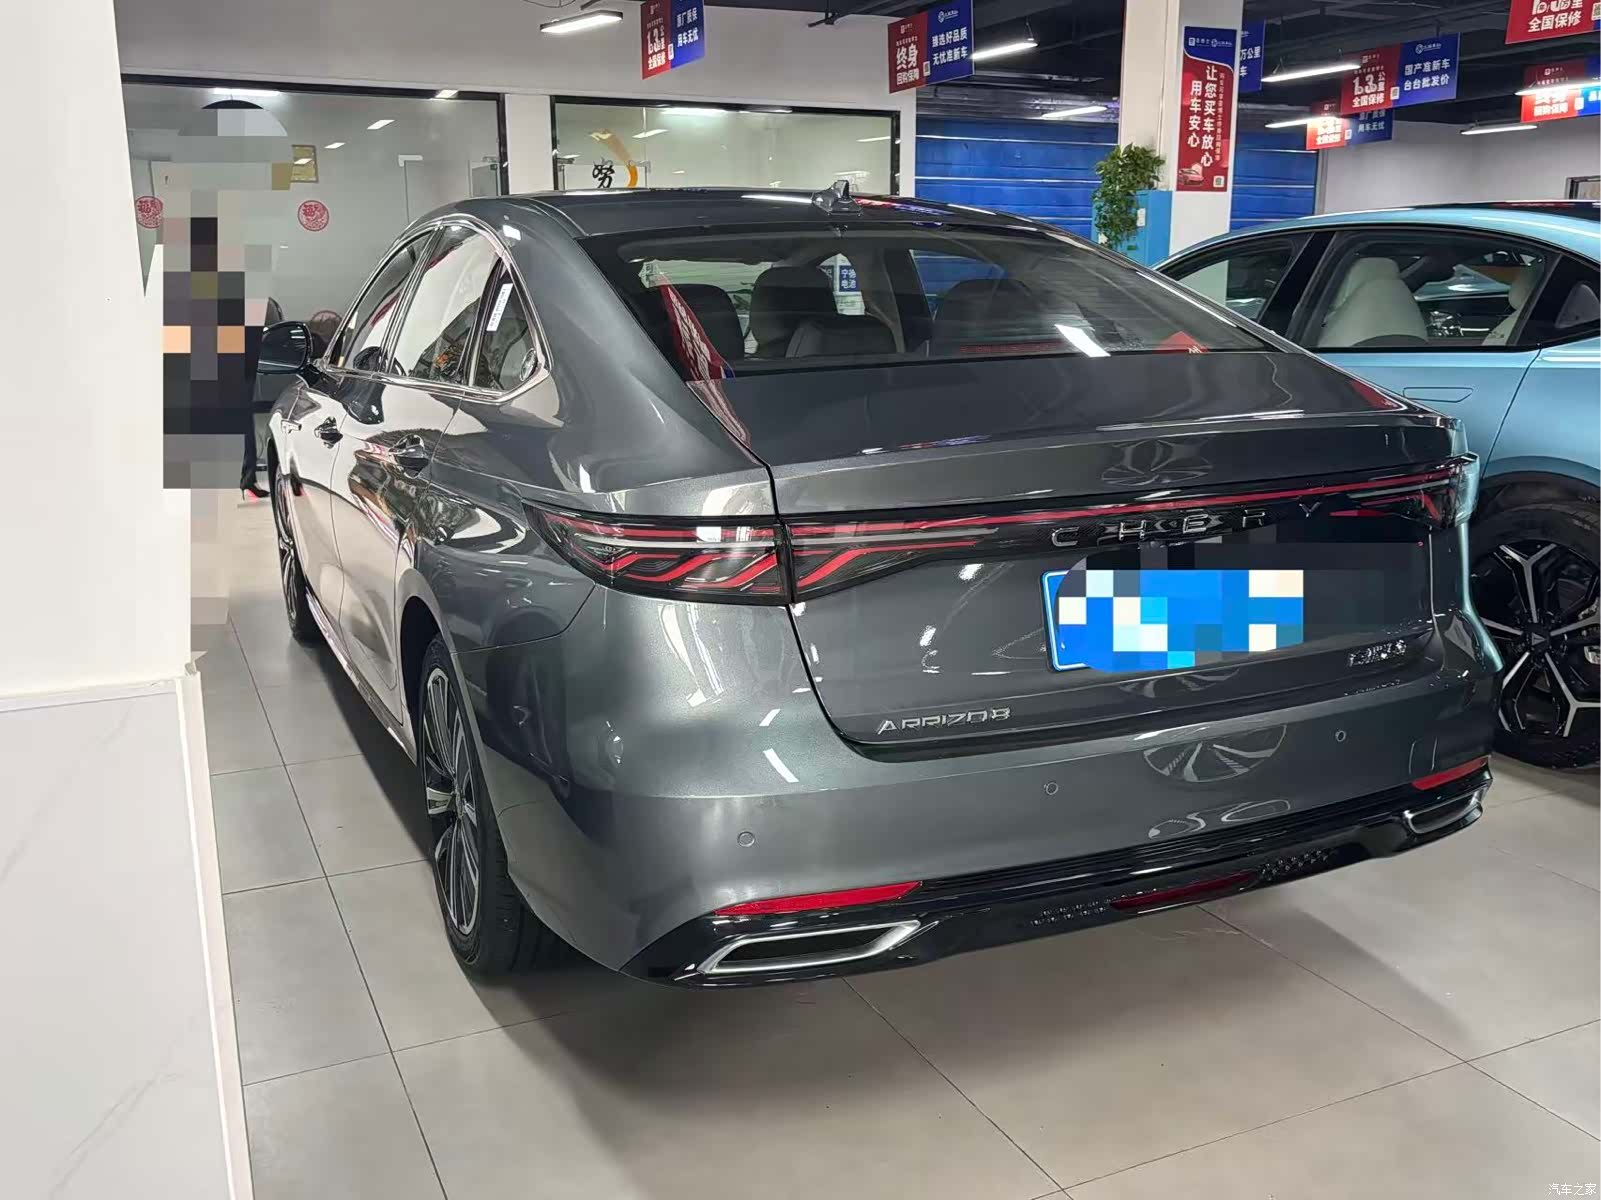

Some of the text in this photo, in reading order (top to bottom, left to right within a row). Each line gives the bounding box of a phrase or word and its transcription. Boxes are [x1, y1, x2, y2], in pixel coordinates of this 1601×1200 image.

[1528, 10, 1582, 33] 全国保修
[931, 27, 968, 48] 臻选好品质
[896, 43, 918, 71] 终身
[1404, 58, 1451, 75] 国产准新车
[1404, 74, 1450, 91] 台台批发价
[1352, 93, 1385, 107] 全国保修
[1187, 80, 1202, 148] 用车安心
[1200, 65, 1218, 167] 让您买车放心
[1051, 502, 1321, 547] CHERY
